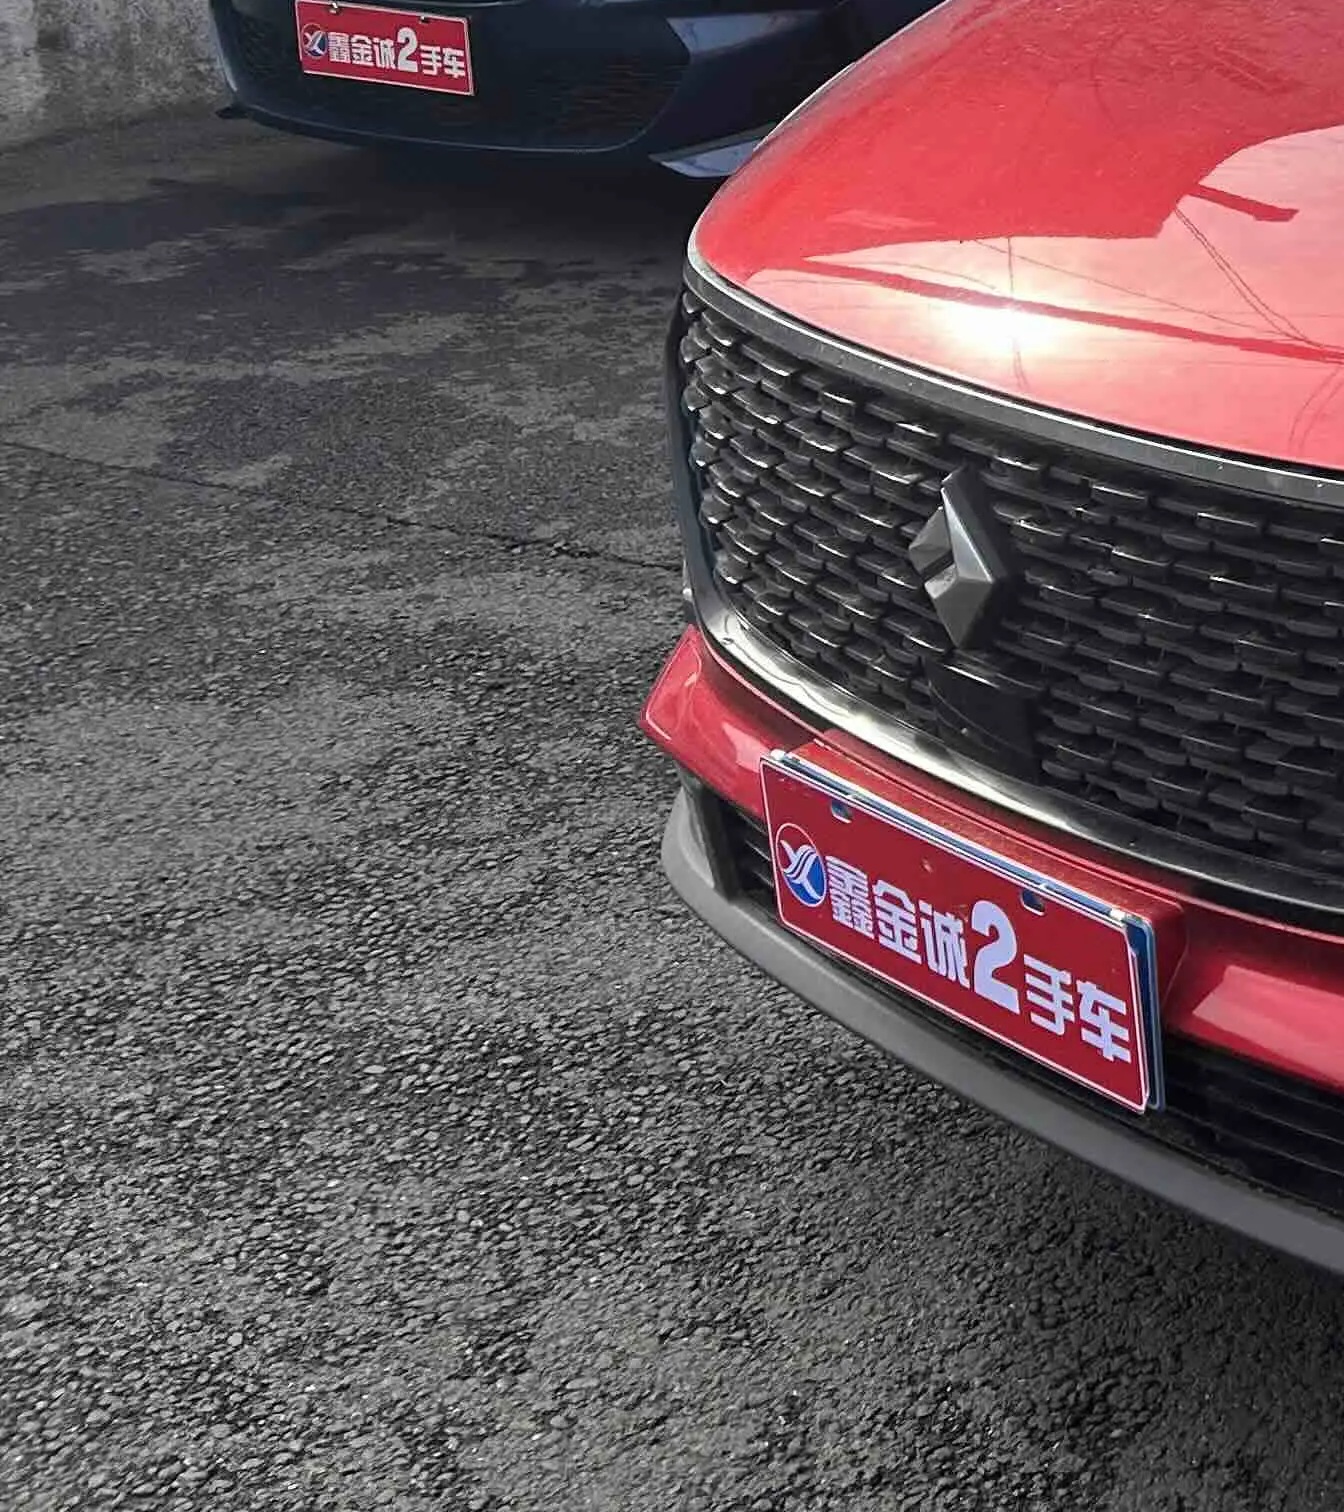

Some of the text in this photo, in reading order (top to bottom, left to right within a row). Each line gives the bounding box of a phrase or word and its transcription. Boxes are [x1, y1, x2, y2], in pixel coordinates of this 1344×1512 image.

[328, 28, 465, 78] 鑫金诚2手车
[827, 857, 1131, 1062] 鑫金诚2手车
